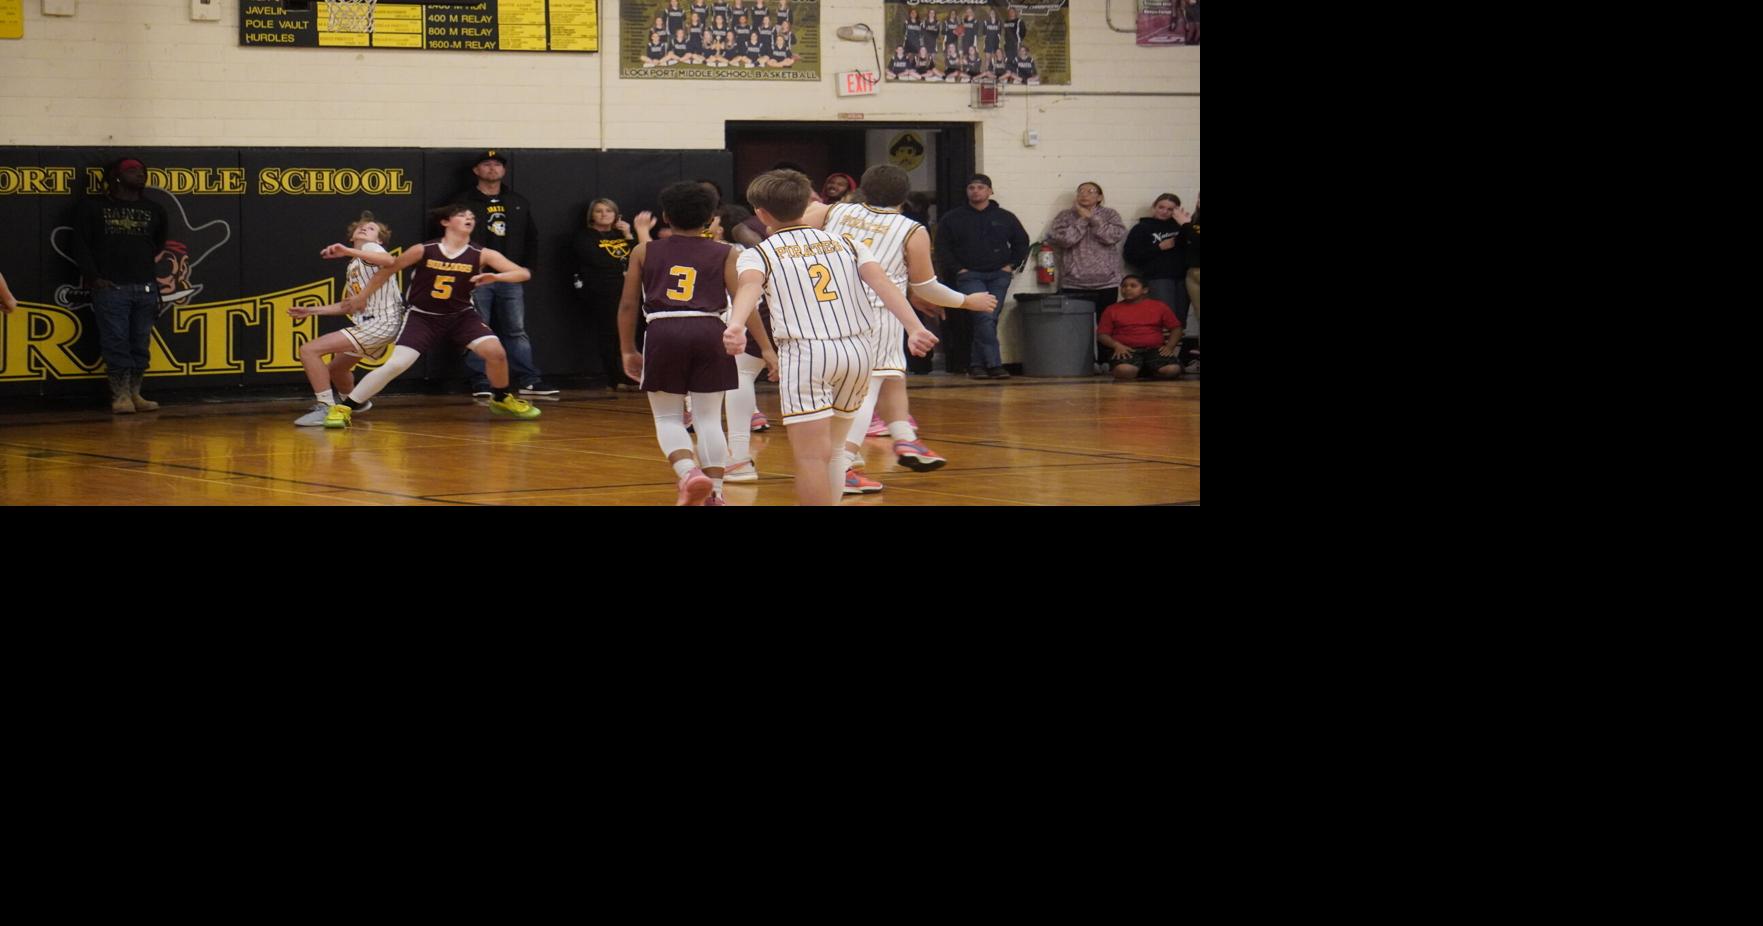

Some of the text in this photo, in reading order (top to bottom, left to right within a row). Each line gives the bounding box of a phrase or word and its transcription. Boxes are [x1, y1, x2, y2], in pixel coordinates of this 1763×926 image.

[246, 6, 287, 15] JAVELIN
[428, 14, 493, 23] 400 M RELAY
[245, 20, 309, 29] POLE VAULT
[428, 28, 493, 36] 800 M RELAY
[245, 34, 295, 43] HURDLES
[464, 41, 496, 50] RELAY
[623, 68, 676, 78] LOCKPORT
[715, 70, 752, 78] SCHOOL
[755, 71, 817, 79] BASKETBALL
[847, 72, 873, 94] EXIT
[86, 167, 247, 195] MDDLE
[258, 167, 412, 195] SCHOOL
[775, 241, 844, 258] PIRATES
[430, 275, 456, 300] 5
[666, 265, 698, 302] 3
[807, 264, 838, 302] 2
